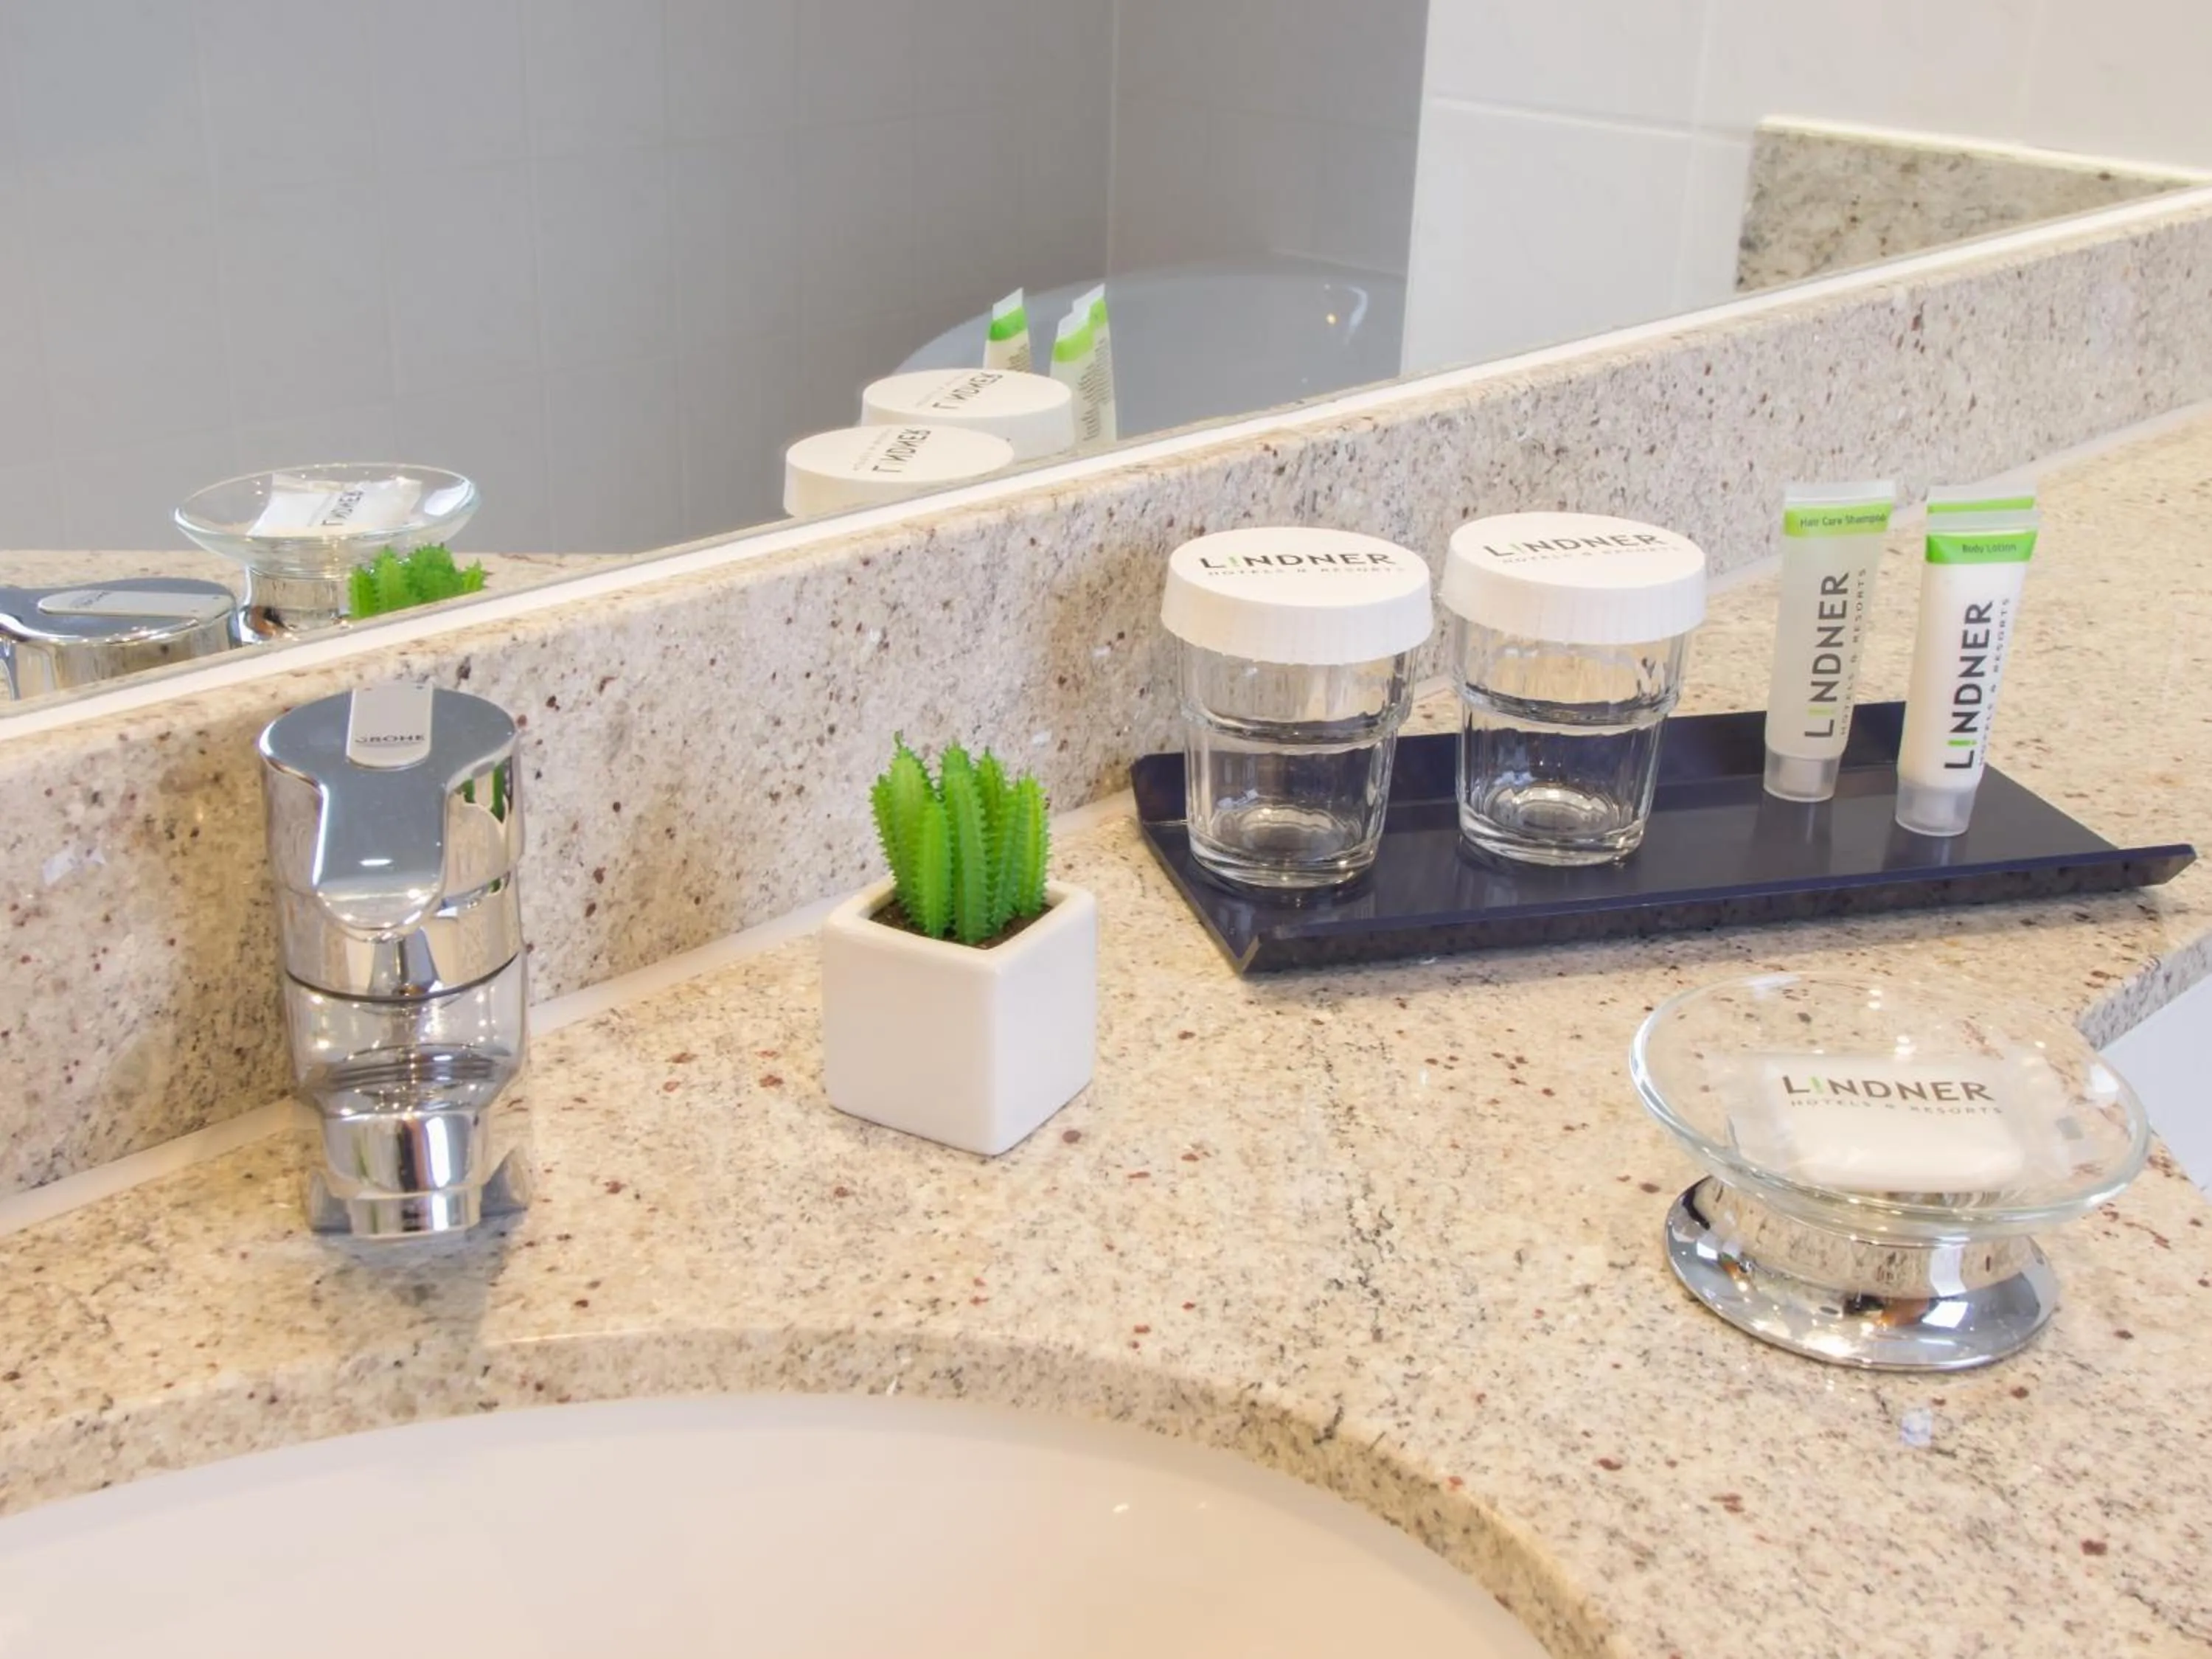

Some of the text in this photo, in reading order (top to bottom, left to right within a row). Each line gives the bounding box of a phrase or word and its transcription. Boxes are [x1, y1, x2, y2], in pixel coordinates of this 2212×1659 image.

[1822, 516, 1843, 526] Care
[1484, 534, 1668, 557] LINDNER
[1962, 543, 1984, 554] Body
[1199, 553, 1396, 569] LINDNER
[1804, 571, 1849, 737] LINDNER
[1944, 599, 1993, 769] LINDNER
[1781, 1075, 1995, 1102] LINDNER
